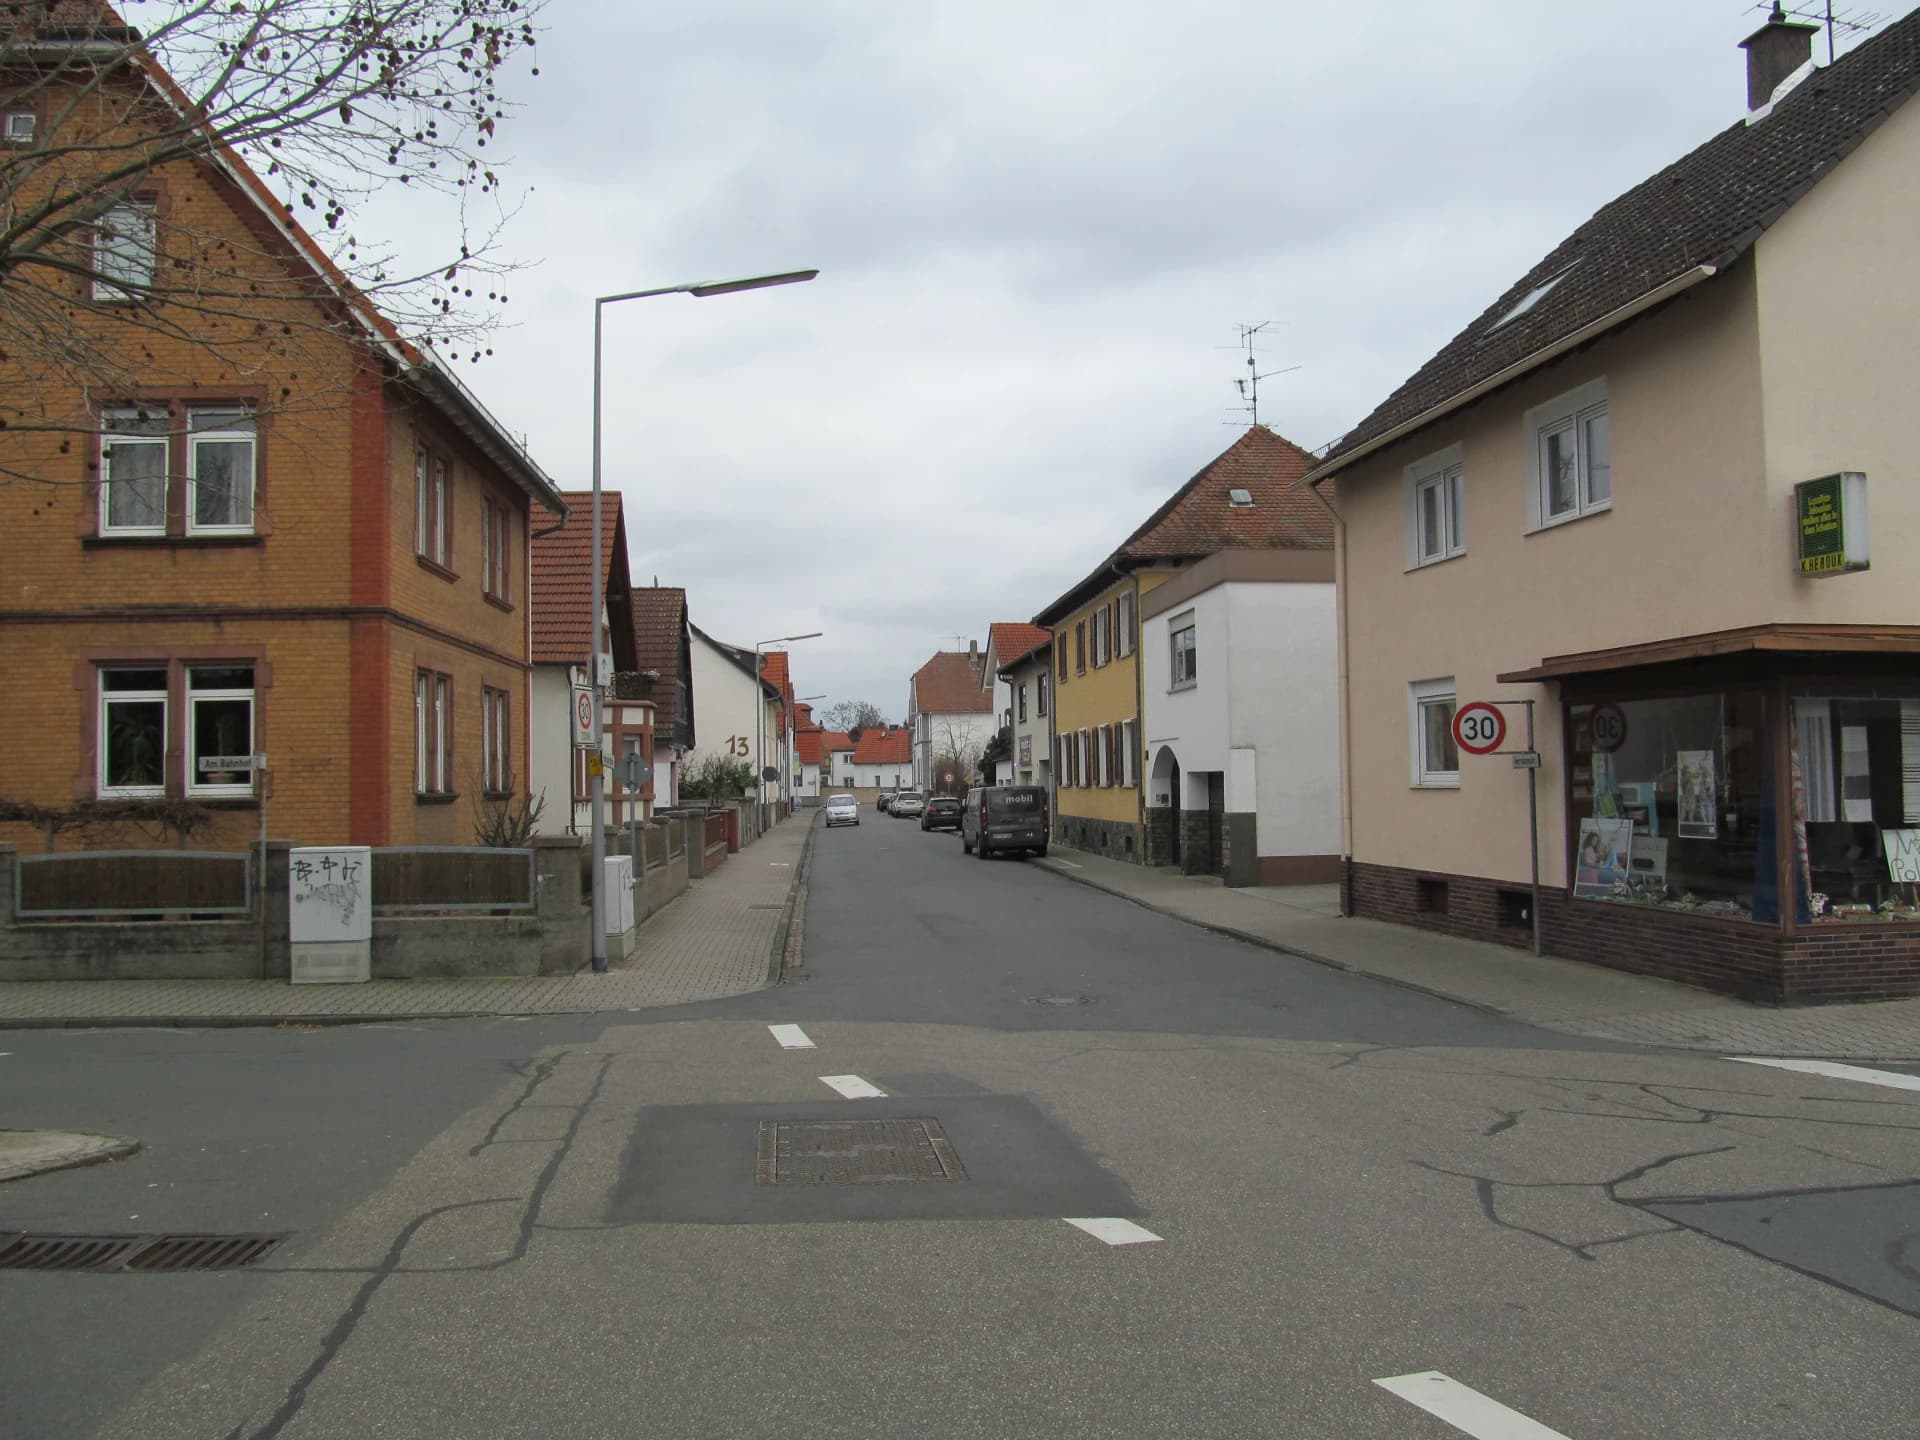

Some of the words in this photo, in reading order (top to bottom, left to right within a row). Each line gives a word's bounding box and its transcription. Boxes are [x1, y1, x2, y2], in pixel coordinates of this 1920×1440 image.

[1464, 716, 1494, 740] 30
[725, 735, 749, 757] 13
[205, 759, 217, 769] Am
[1005, 794, 1033, 806] mobil
